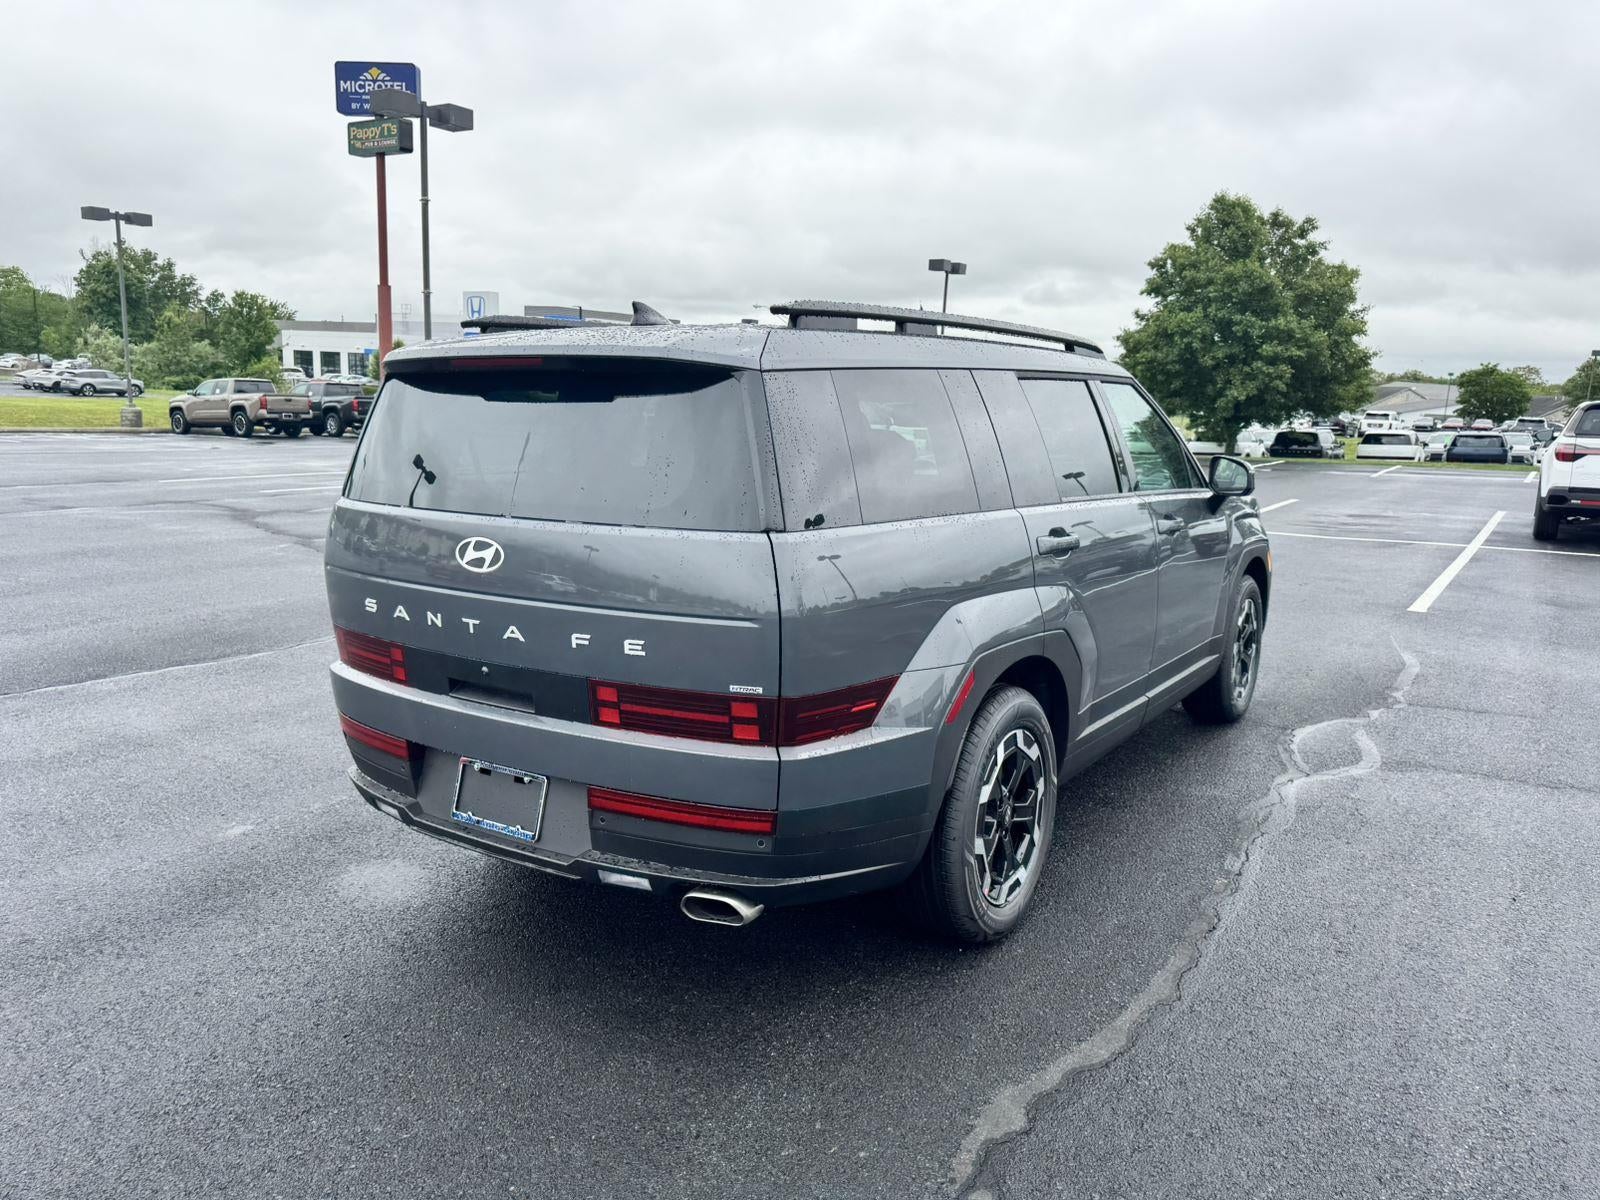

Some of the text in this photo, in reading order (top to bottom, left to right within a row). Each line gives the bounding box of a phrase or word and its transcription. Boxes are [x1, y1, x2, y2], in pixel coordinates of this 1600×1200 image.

[340, 80, 410, 93] MICROTEL
[350, 123, 397, 139] Pappy T's
[365, 598, 646, 656] SANTA FE
